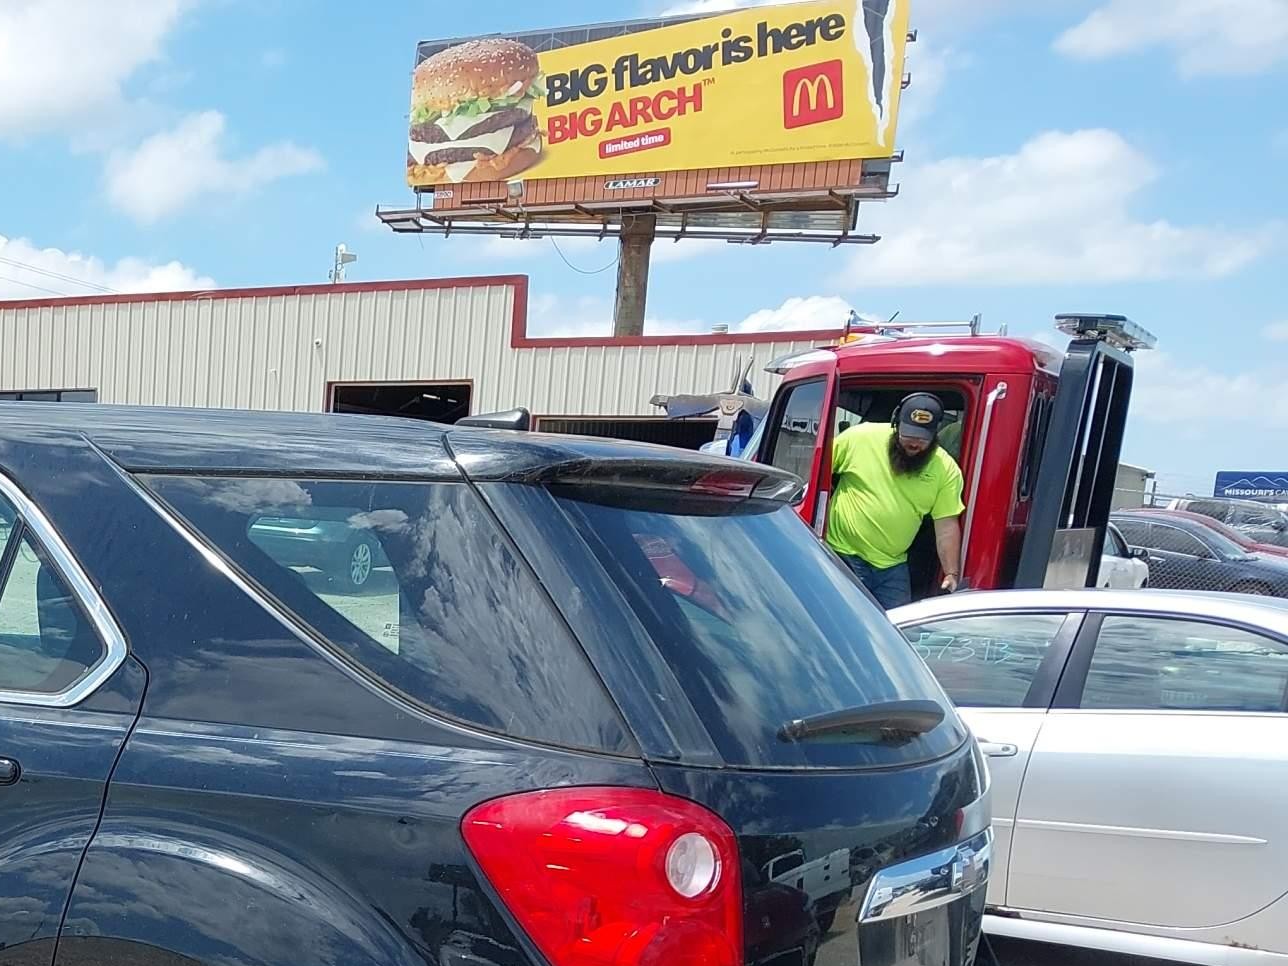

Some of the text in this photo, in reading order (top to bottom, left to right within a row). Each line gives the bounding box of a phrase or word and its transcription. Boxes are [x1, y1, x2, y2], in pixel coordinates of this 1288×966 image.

[546, 13, 845, 107] BIG flavor is here
[547, 107, 603, 145] BIG
[605, 134, 665, 154] limited time
[608, 178, 657, 189] LAMAR
